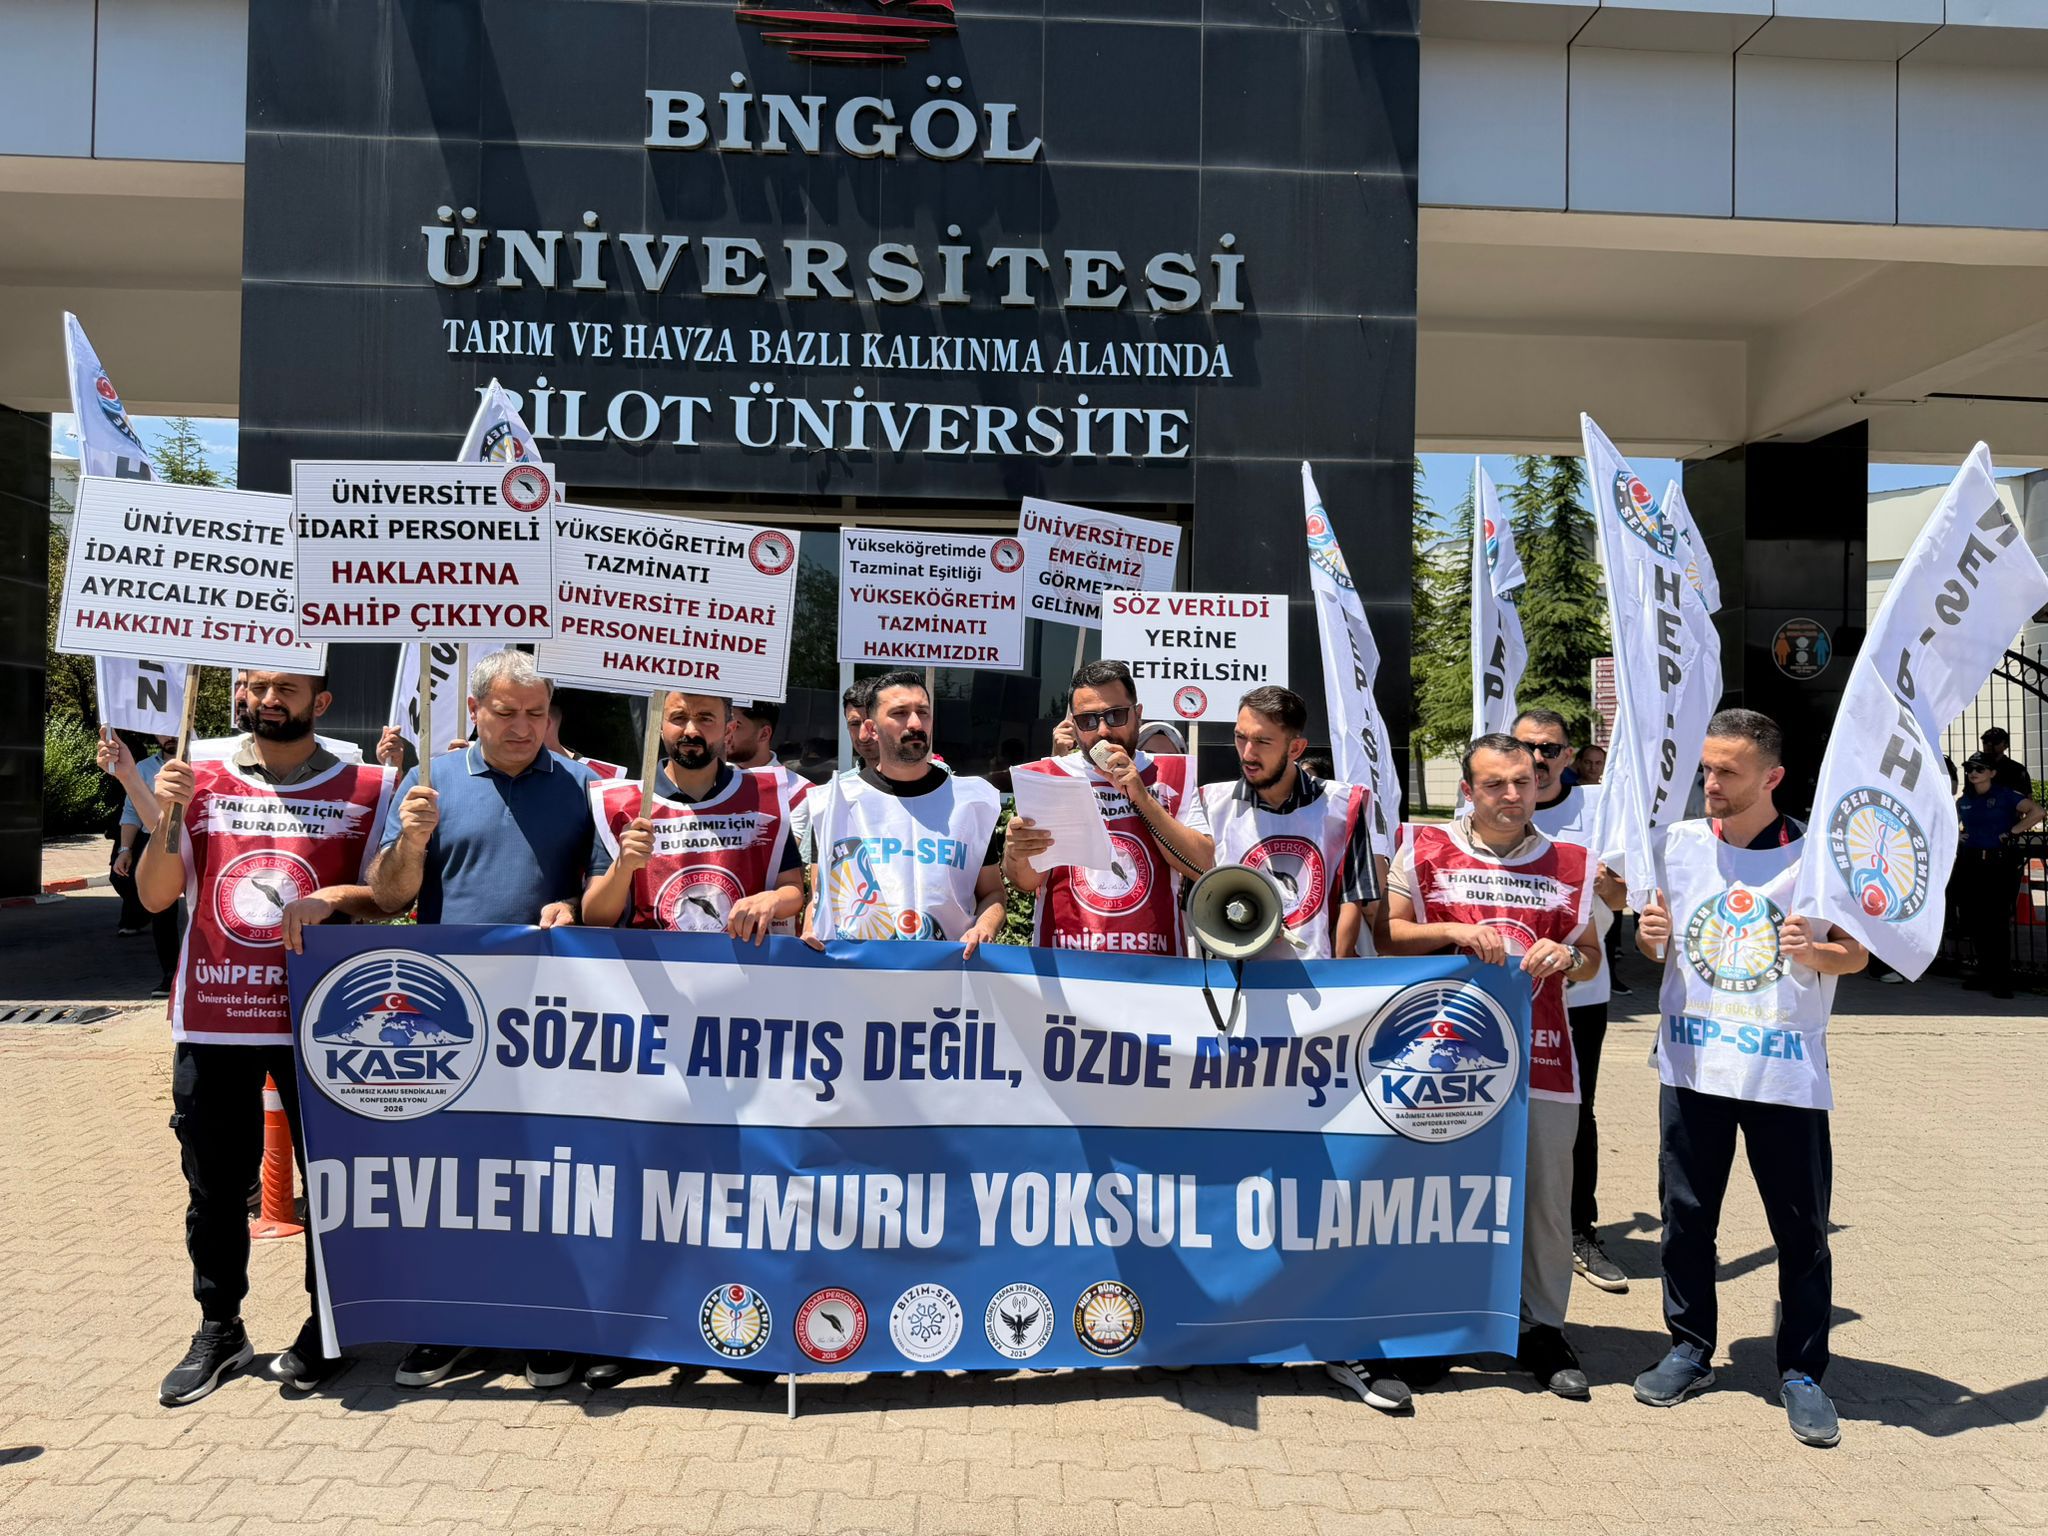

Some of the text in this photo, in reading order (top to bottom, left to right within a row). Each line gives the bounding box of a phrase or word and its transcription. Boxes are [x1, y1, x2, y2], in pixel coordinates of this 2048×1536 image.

[644, 71, 1042, 164] BİNGÖL
[421, 205, 1246, 314] ÜNİVERSİTESİ
[443, 318, 1234, 379] TARIM VE HAVZA BAZLI KALKINMA ALANINDA
[730, 382, 1190, 459] ÜNİVERSİTE
[332, 478, 497, 506] ÜNİVERSİTE
[123, 508, 285, 546] ÜNİVERSİTE
[298, 513, 540, 542] İDARİ PERSONELİ
[555, 517, 745, 559] YÜKSEKÖĞRETİM
[1023, 510, 1175, 557] ÜNİVERSİTEDE
[84, 536, 294, 580] İDARİ PERSONE
[846, 537, 987, 560] Yükseköğretimde
[1049, 547, 1142, 577] EMEĞİMİZ
[332, 560, 519, 585] HAKLARINA
[584, 553, 710, 583] TAZMİNATI
[850, 560, 982, 582] Tazminat Eşitliği
[80, 576, 294, 614] AYRICALIK DEĞ
[558, 581, 775, 626] ÜNİVERSİTE İDARİ
[849, 587, 1016, 611] YÜKSEKÖĞRETİM
[1112, 592, 1271, 619] SÖZ VERİLDİ
[76, 608, 192, 638] HAKKINI
[302, 597, 551, 632] SAHİP ÇIKIYOR
[877, 613, 988, 636] TAZMİNATI
[561, 615, 767, 655] PERSONELİNİNDE
[1144, 625, 1237, 650] YERİNE
[863, 640, 1000, 662] HAKKIMIZDIR
[602, 651, 721, 681] HAKKIDIR
[1120, 656, 1268, 683] ETİRİLSİN!
[214, 799, 311, 816] HAKLARIMIZ
[231, 819, 326, 835] BURADAYIZ!
[653, 821, 726, 834] AKLARIMIZ
[660, 836, 743, 851] BURADAYIZ!
[1448, 873, 1532, 890] HAKLARIMIZ
[1103, 900, 1123, 908] 2015
[1465, 890, 1547, 907] BURADAYIZ!
[249, 929, 273, 938] 2015
[1051, 926, 1168, 952] ÜNİPERSEN
[195, 958, 288, 985] ÜNİPER
[1720, 979, 1758, 992] HEP
[226, 1006, 288, 1018] Sendikası
[1669, 1014, 1804, 1061] HEP-SEN
[496, 996, 1352, 1109] SÖZDE ARTIŞ DEĞİL, ÖZDE ARTIŞ!
[326, 1050, 461, 1084] KASK
[340, 1087, 376, 1095] BAĞIMSIZ
[399, 1087, 447, 1096] SENDİKALARI
[1380, 1074, 1497, 1109] KASK
[1395, 1110, 1484, 1120] BAĞIMSIZ KAMU SENDİKALARI
[1411, 1119, 1467, 1127] KONFEDERASYONU
[309, 1146, 1513, 1252] DEVLETİN MEMURU YOKSUL OLAMAZ!
[722, 1347, 748, 1356] HEP
[1010, 1350, 1027, 1358] 2024
